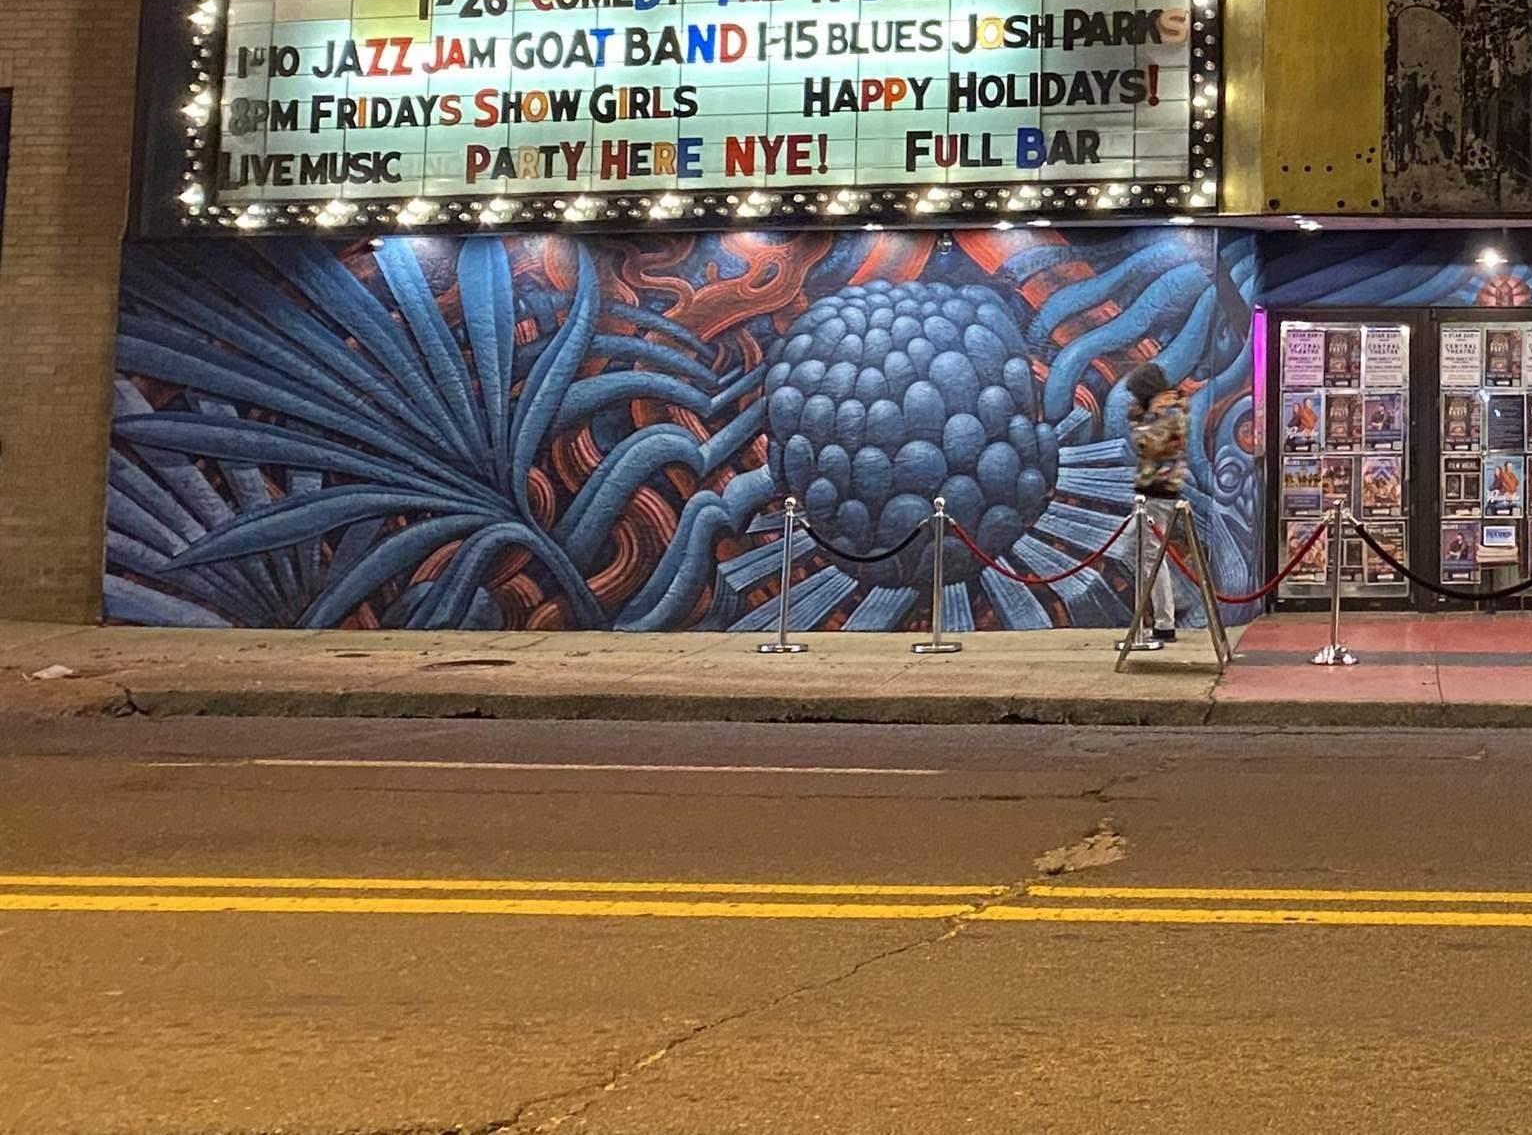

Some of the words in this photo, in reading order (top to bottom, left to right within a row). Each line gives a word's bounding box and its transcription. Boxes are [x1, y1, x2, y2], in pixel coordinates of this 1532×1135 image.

[312, 36, 413, 79] JAZZ
[423, 36, 496, 75] JAM
[510, 28, 615, 69] GOAT
[625, 22, 748, 67] BAND
[827, 19, 943, 56] BLUES
[952, 12, 1054, 56] JOSH
[1063, 8, 1190, 50] PARKS
[228, 97, 299, 136] 8PM
[310, 92, 462, 134] FRIDAYS
[803, 76, 933, 118] HAPPY
[948, 64, 1160, 113] HOLIDAYS!
[217, 151, 295, 191] LIVE
[299, 150, 402, 185] MUSIC
[465, 140, 587, 185] PARTY
[602, 137, 704, 180] HERE
[725, 133, 829, 177] NYE!
[905, 129, 1003, 172] FULL
[1016, 126, 1101, 170] BAR
